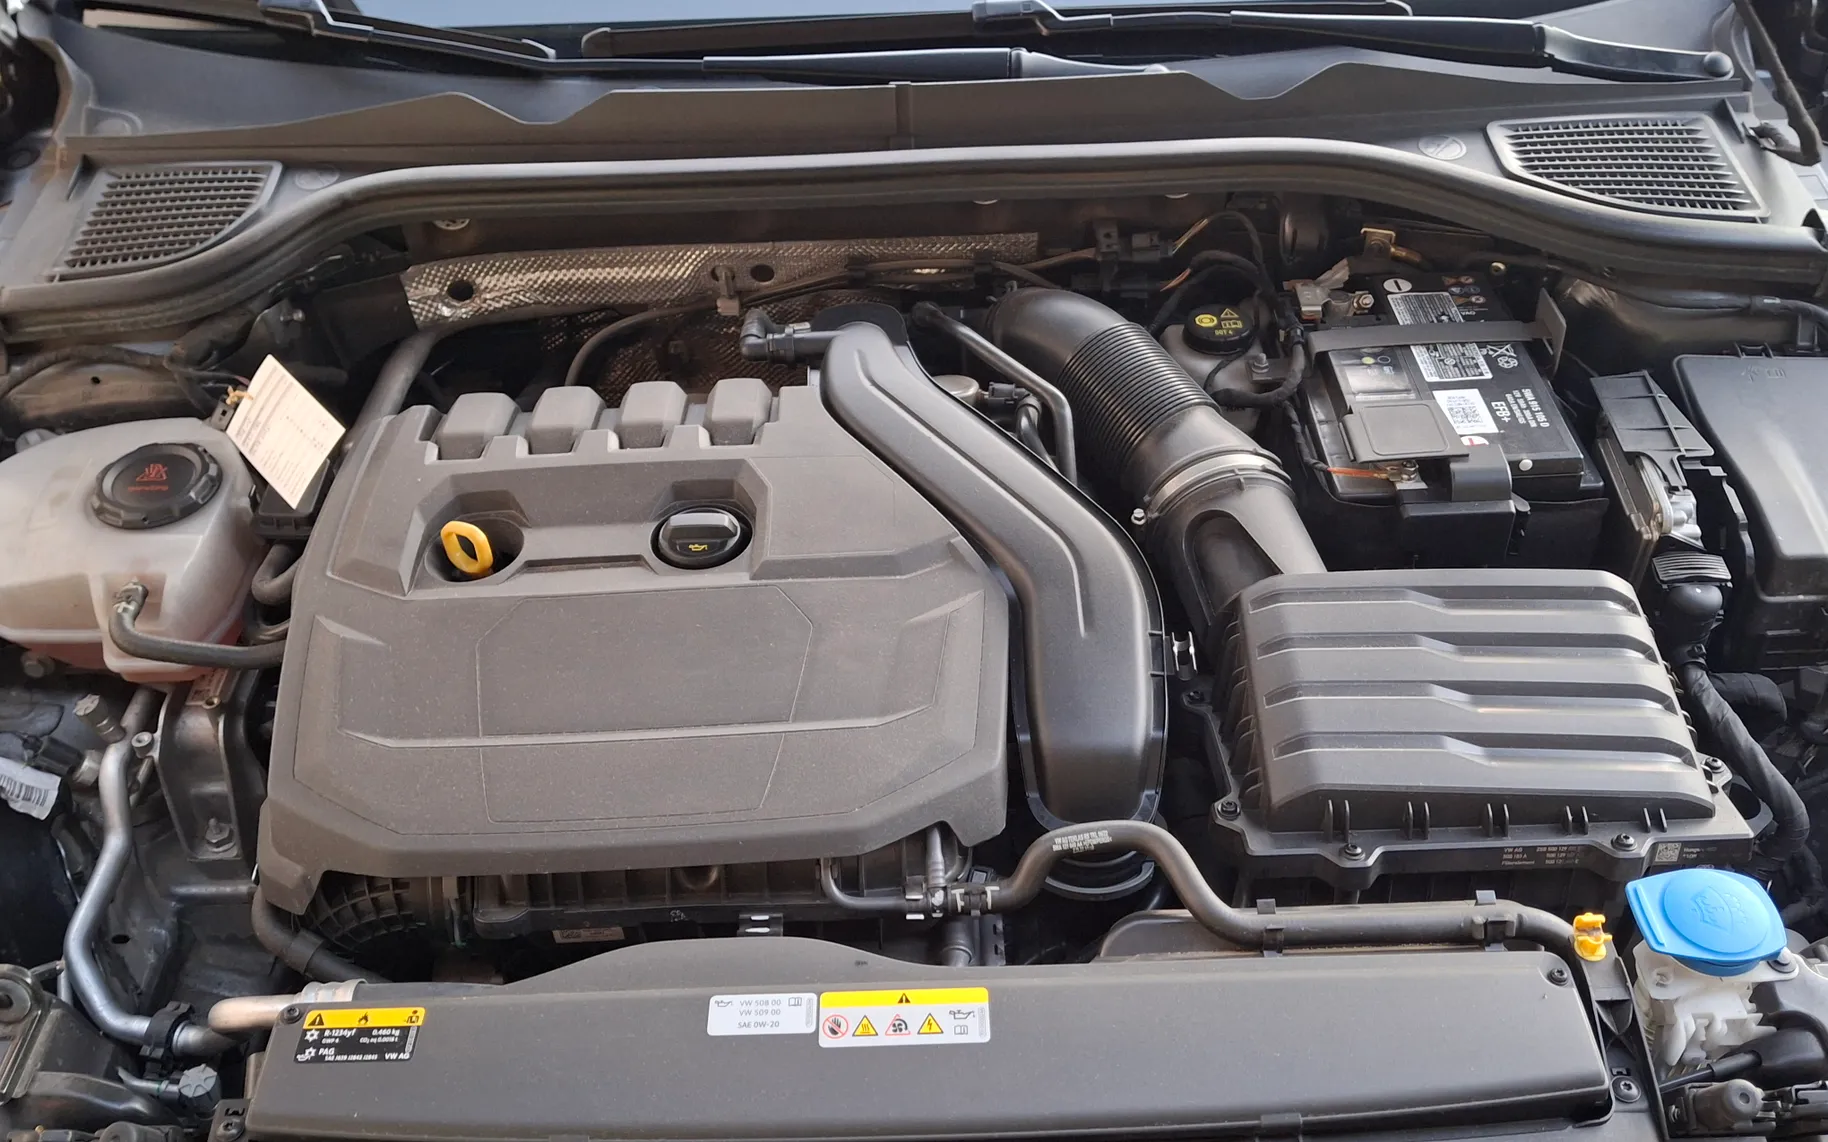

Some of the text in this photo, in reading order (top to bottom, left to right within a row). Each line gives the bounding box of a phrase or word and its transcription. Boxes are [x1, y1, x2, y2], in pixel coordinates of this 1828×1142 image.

[1490, 401, 1512, 422] EFB+
[324, 1028, 356, 1037] R-1234yf
[391, 1028, 400, 1036] kg
[318, 1048, 335, 1056] PAG
